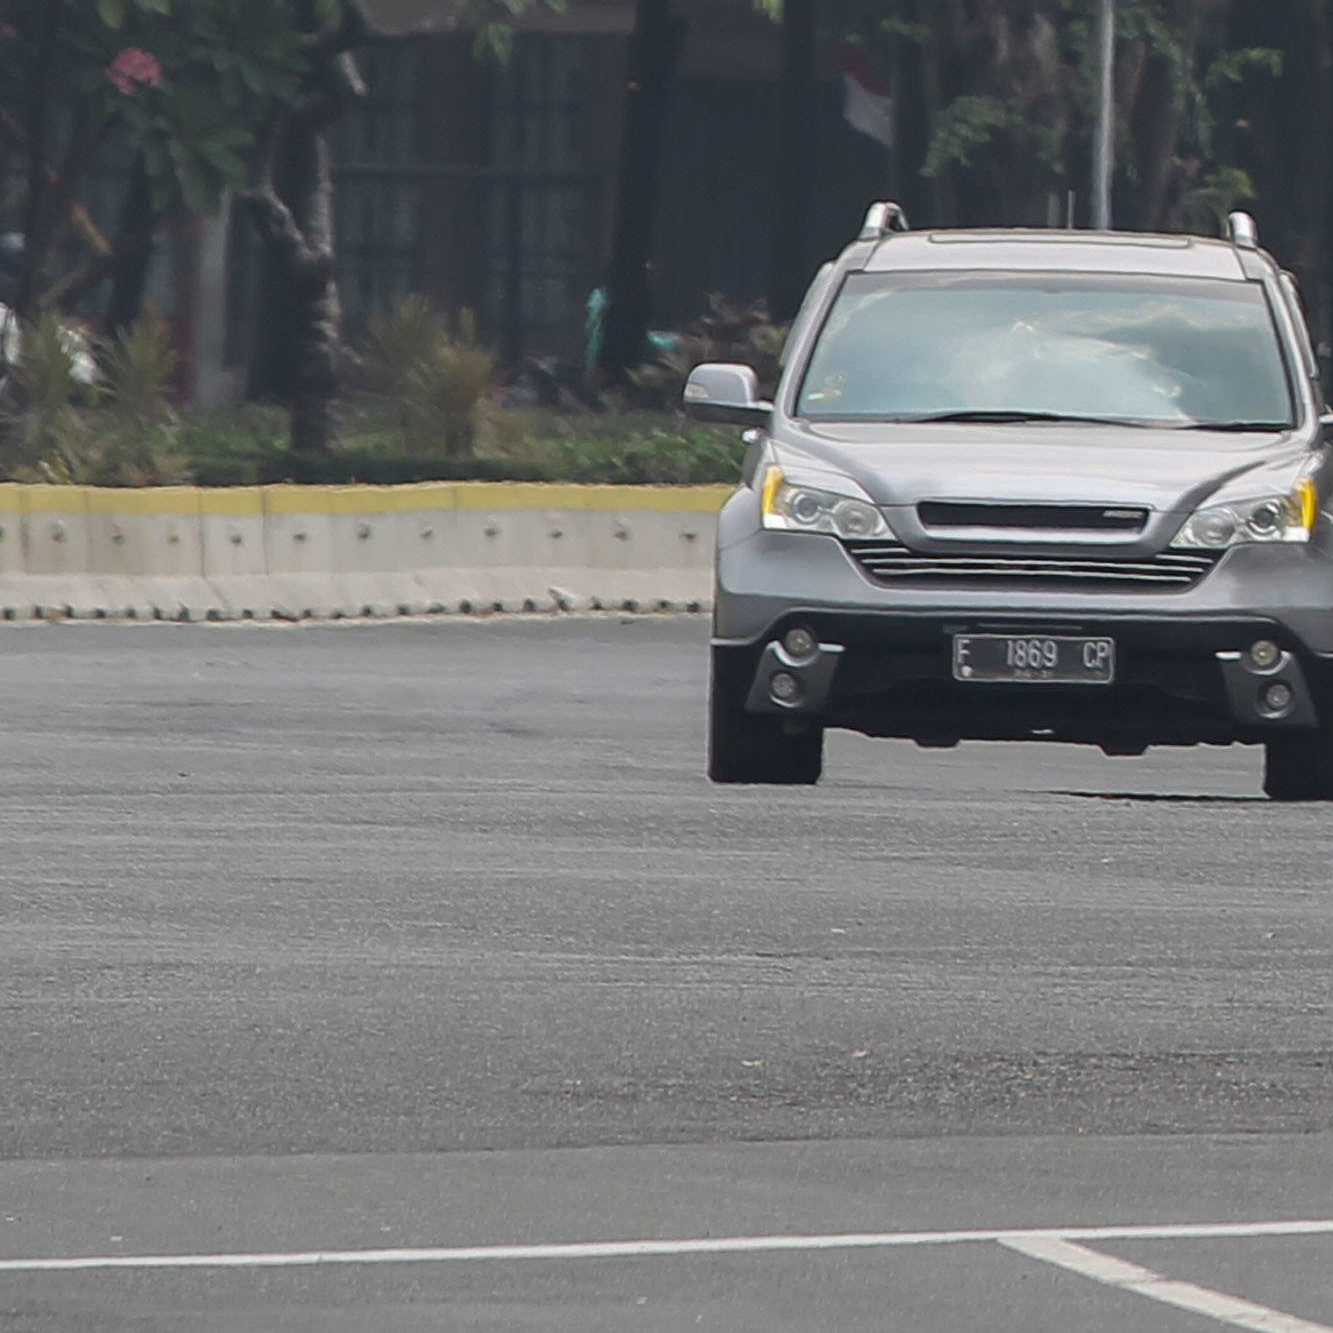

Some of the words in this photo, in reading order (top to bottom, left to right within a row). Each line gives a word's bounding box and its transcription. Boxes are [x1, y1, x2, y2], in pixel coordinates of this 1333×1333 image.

[956, 639, 971, 664] F
[1006, 639, 1058, 668] 1869
[1083, 641, 1109, 669] CP
